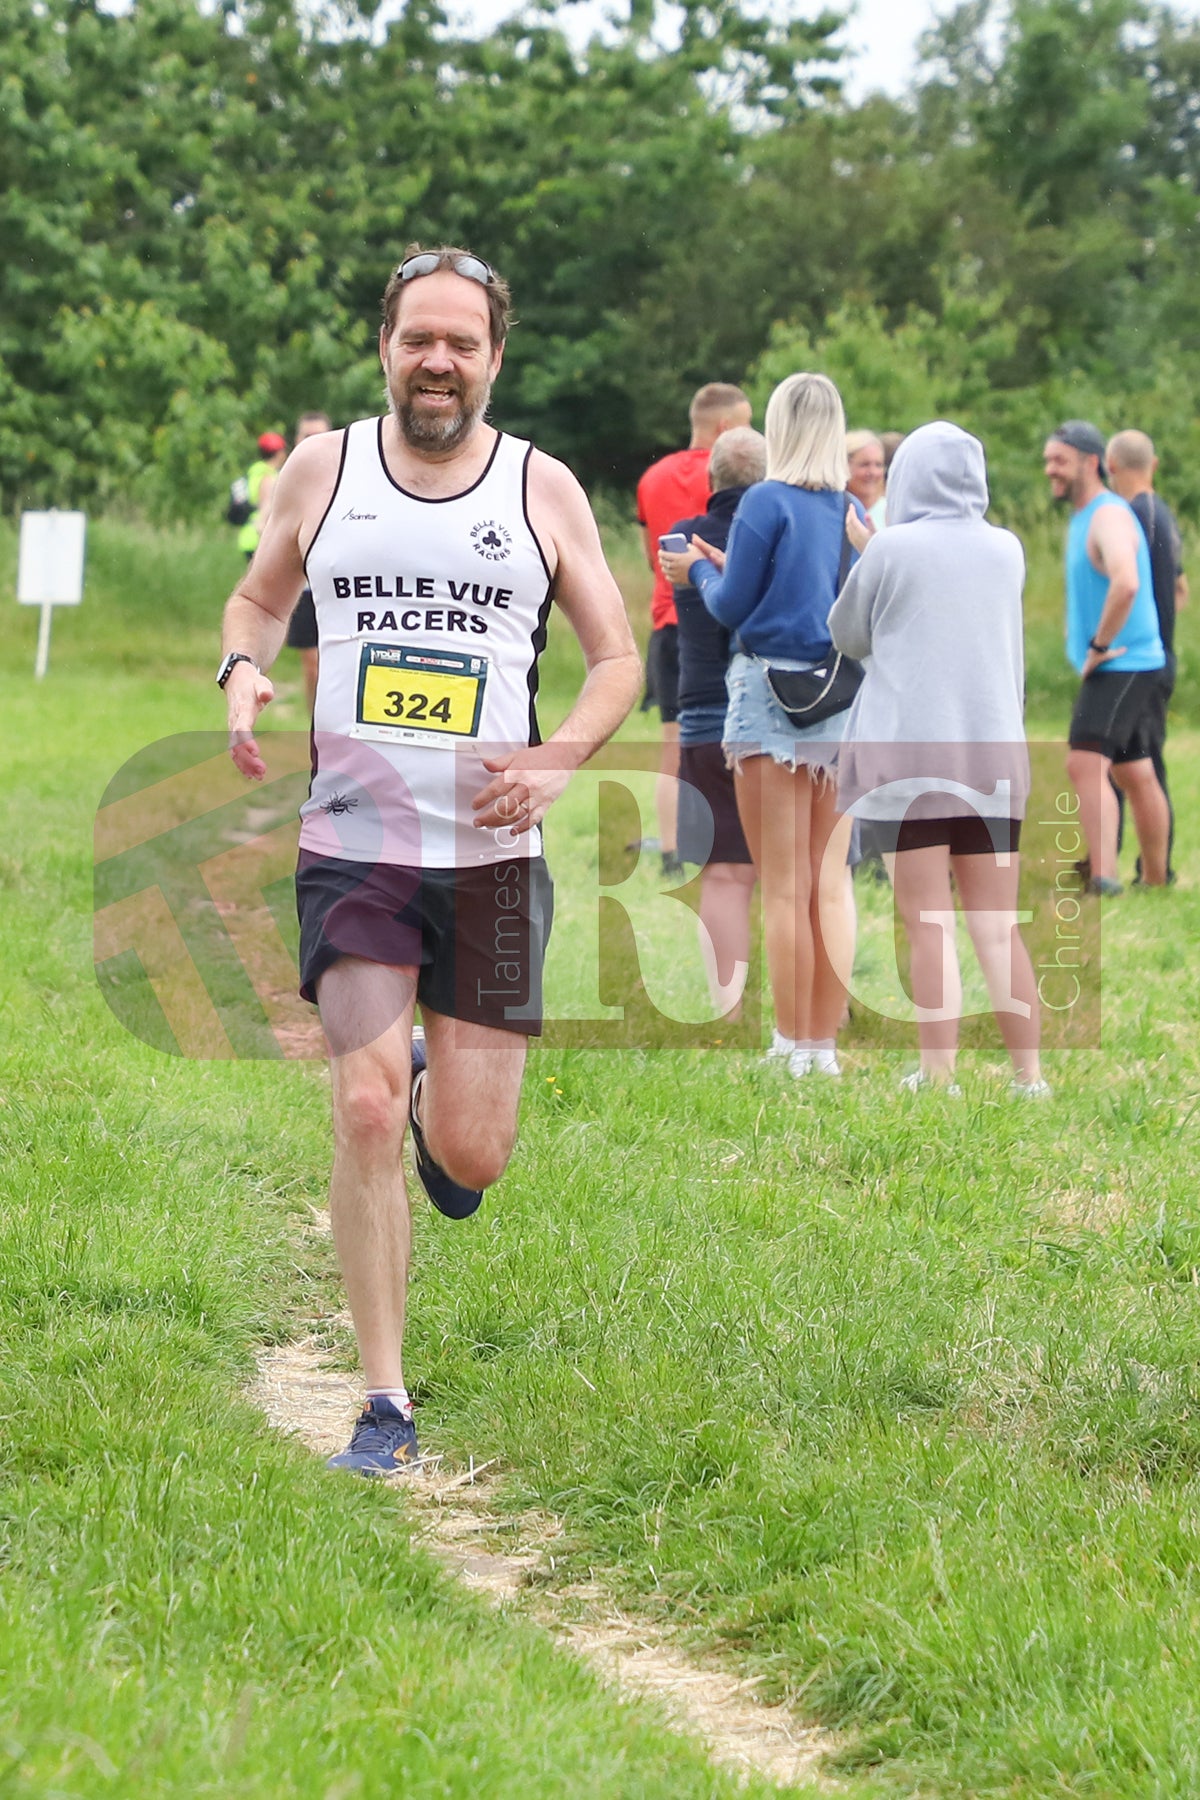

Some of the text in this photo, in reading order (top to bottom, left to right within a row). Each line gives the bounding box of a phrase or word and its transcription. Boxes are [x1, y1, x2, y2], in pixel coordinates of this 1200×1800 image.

[470, 520, 513, 544] BELLE VUE
[473, 543, 511, 561] RACERS
[333, 576, 514, 610] BELLE VUE
[357, 610, 488, 634] RACERS
[383, 691, 452, 723] 324
